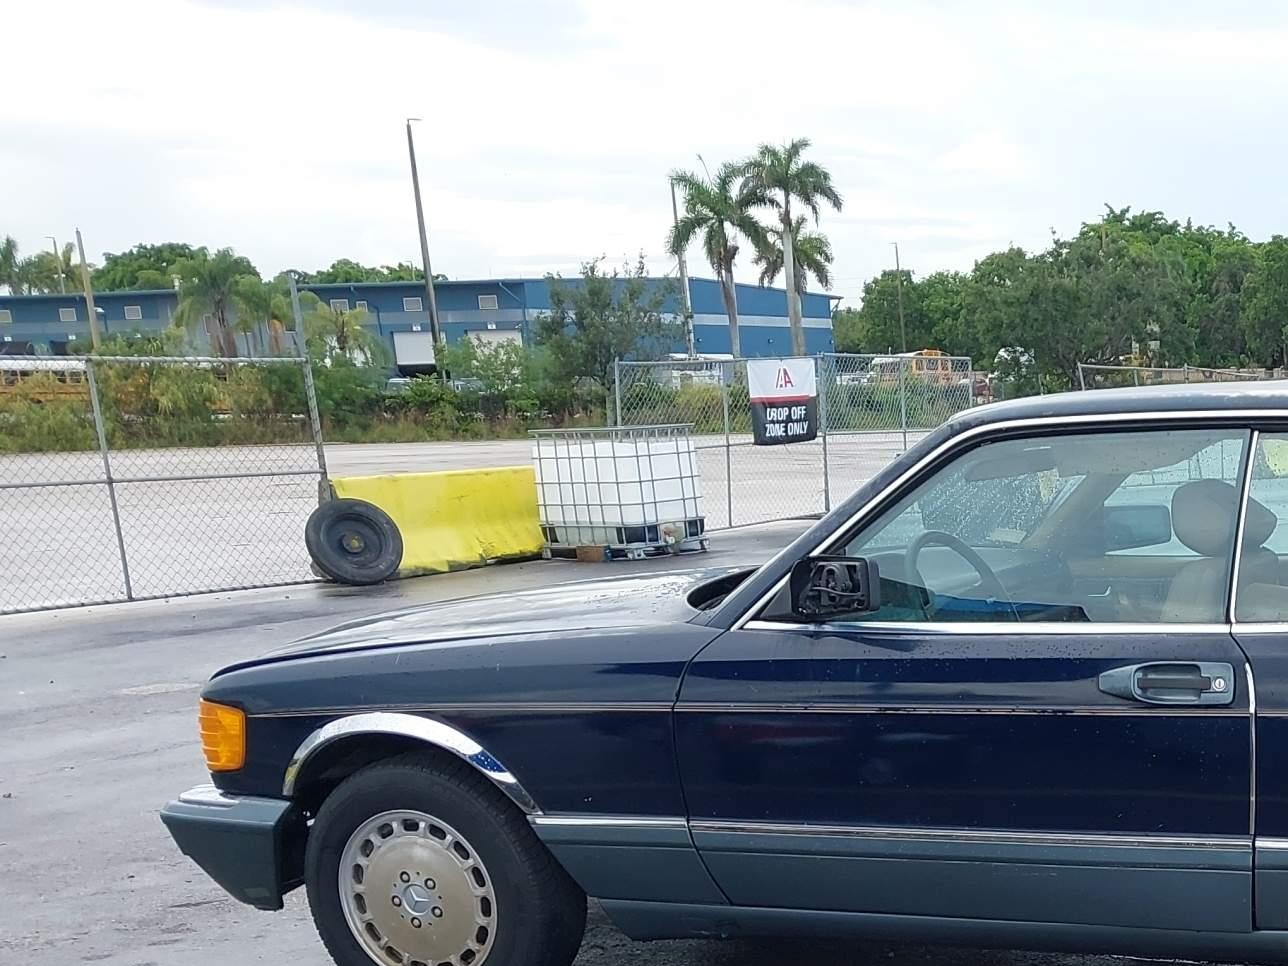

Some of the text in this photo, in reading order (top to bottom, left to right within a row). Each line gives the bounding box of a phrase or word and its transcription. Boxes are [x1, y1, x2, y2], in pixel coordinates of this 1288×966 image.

[791, 406, 807, 420] OFF
[765, 421, 809, 437] ZONE ONLY
